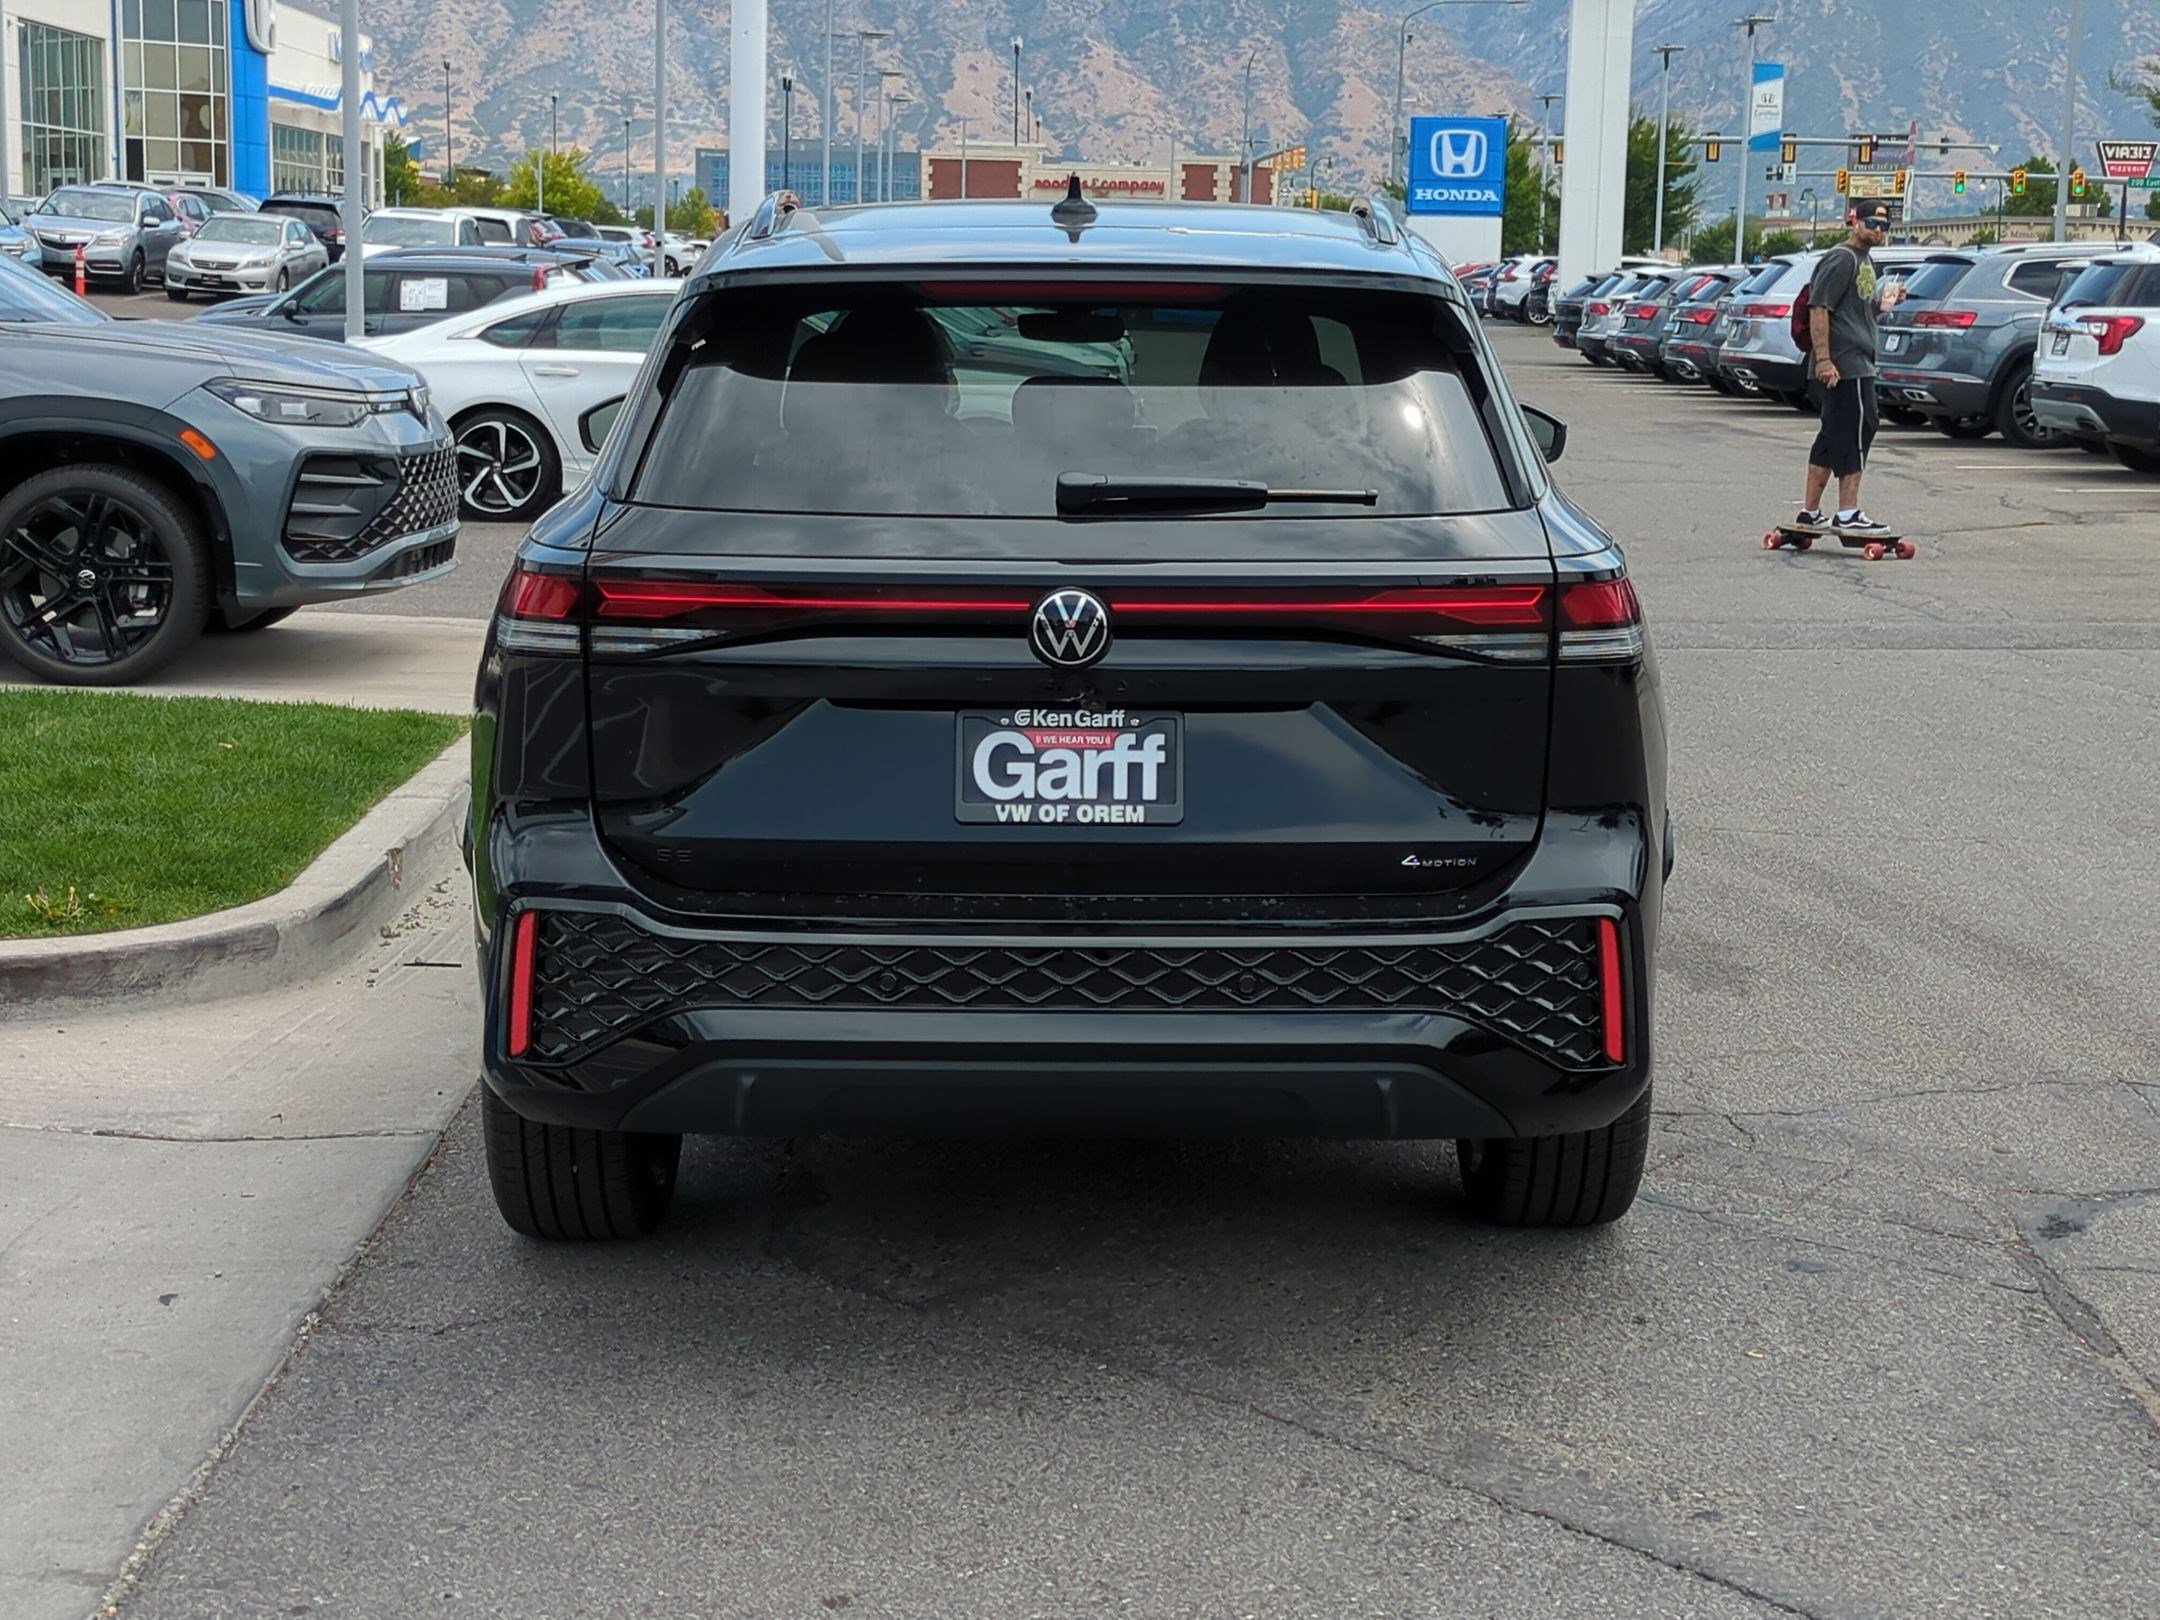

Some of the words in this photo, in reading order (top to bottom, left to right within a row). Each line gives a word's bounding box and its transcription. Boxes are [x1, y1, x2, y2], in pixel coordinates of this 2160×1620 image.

[2105, 146, 2151, 159] VIA313
[1035, 174, 1089, 189] noods
[1101, 180, 1165, 194] company
[1415, 188, 1499, 201] HONDA
[1074, 709, 1126, 727] Garff
[1043, 735, 1057, 744] WE
[1059, 735, 1084, 744] HEAR
[1086, 736, 1104, 744] YOU
[973, 731, 1166, 800] Garff
[995, 804, 1032, 823] VW
[1038, 804, 1070, 823] OF
[1076, 804, 1145, 823] OREM
[1401, 854, 1477, 868] 4MOTION
